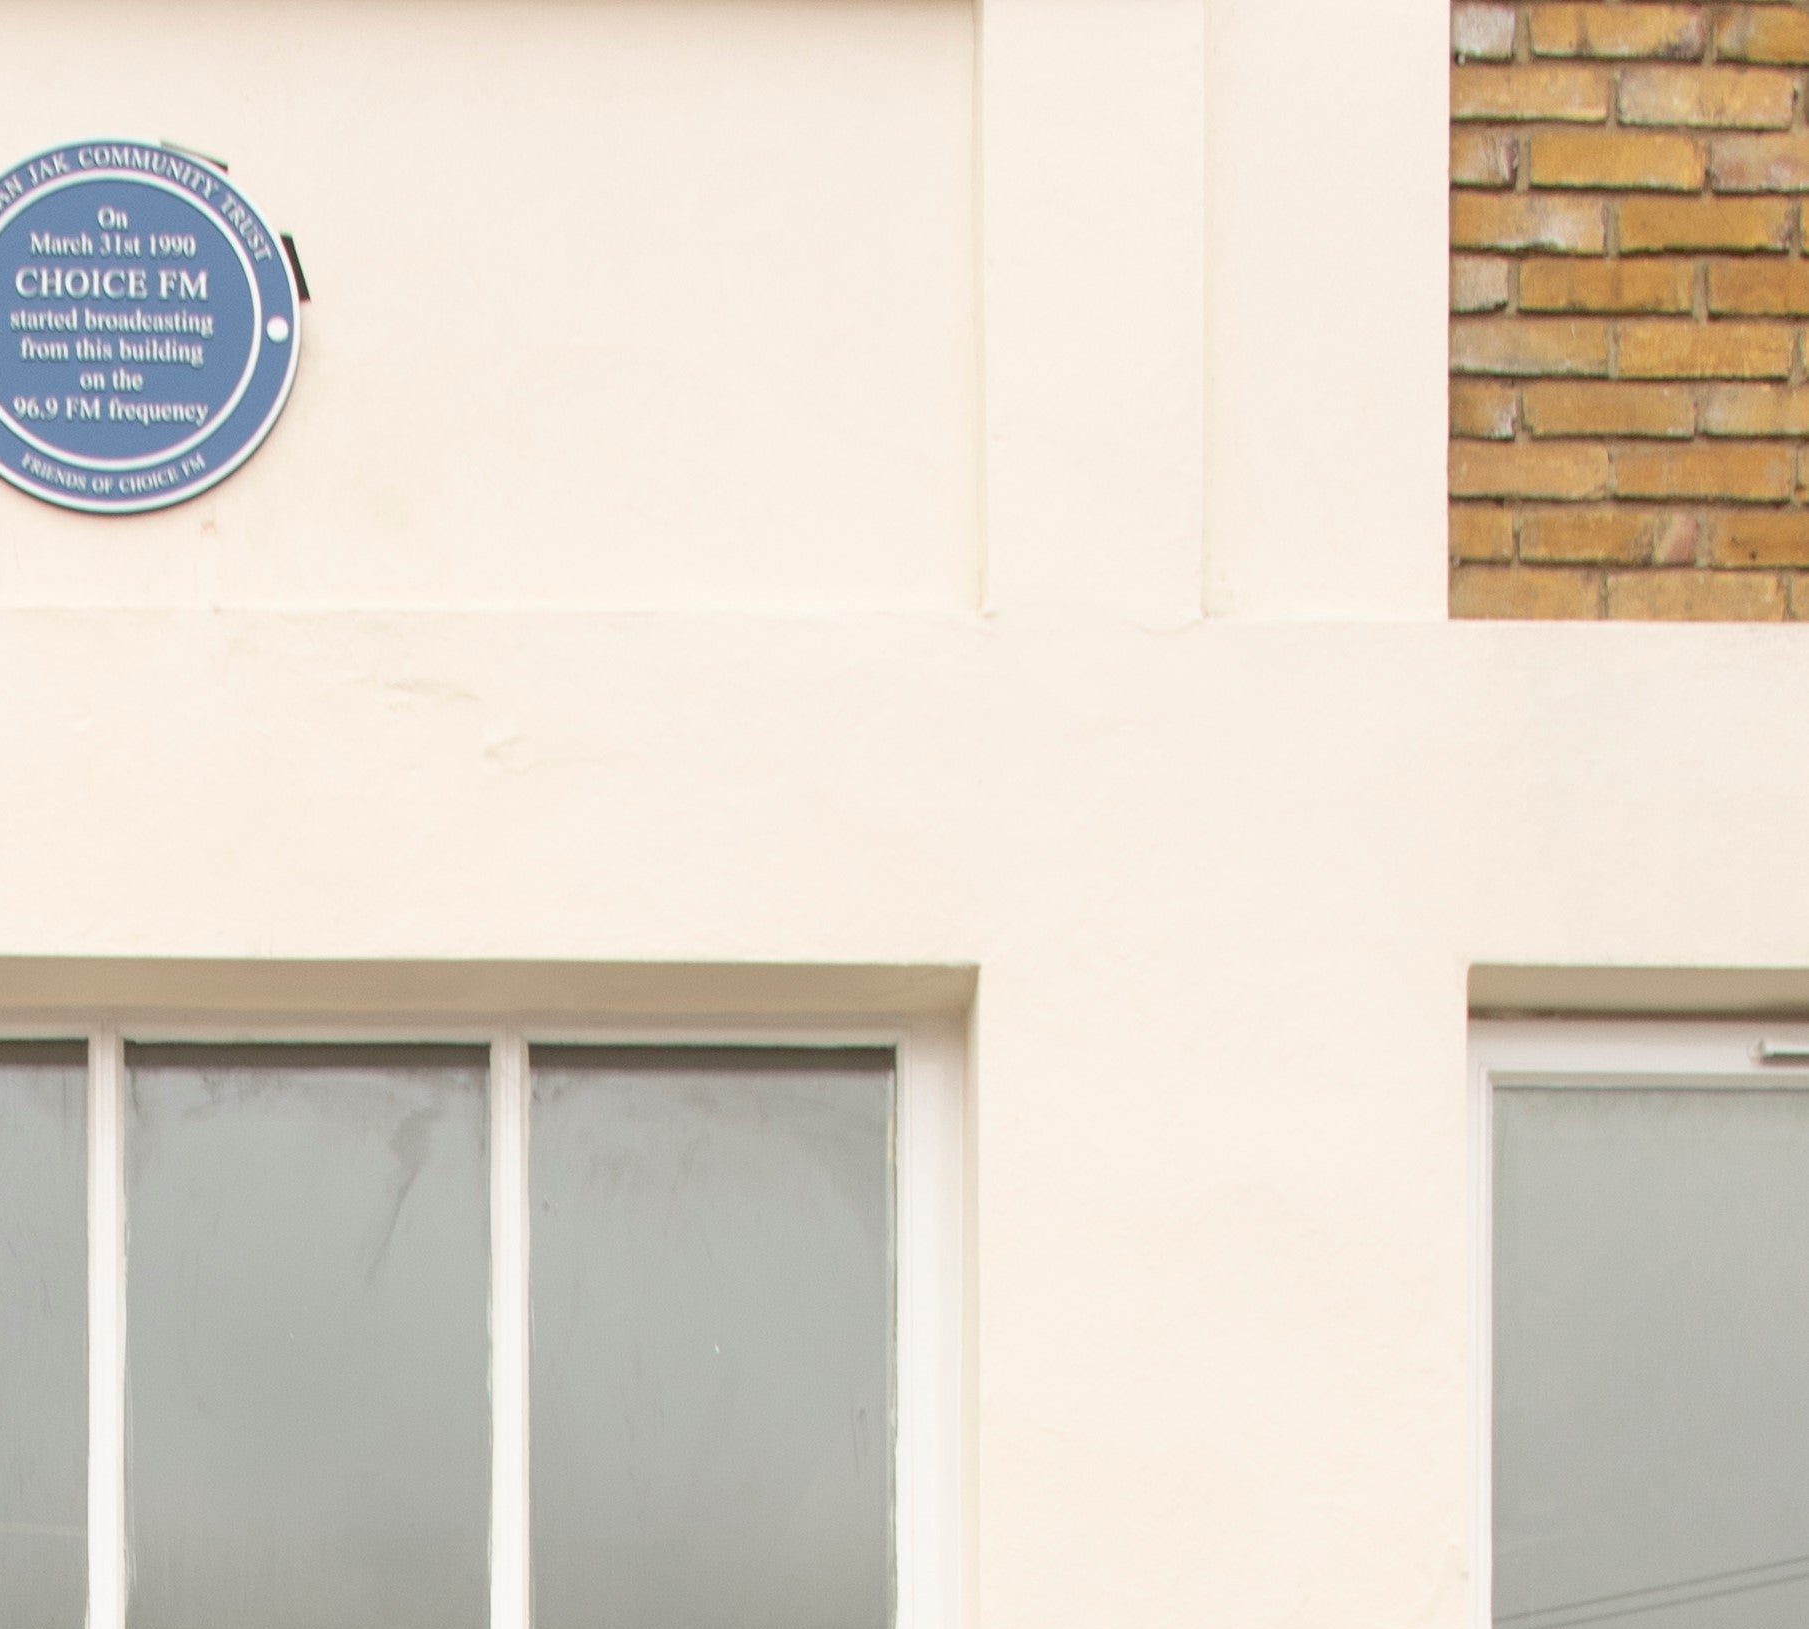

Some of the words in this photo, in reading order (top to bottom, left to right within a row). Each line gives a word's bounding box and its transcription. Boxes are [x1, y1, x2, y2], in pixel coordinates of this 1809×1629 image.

[28, 152, 70, 187] JAK
[78, 146, 219, 199] COMMUNITY
[221, 194, 272, 262] TRUST
[98, 206, 128, 230] On
[30, 231, 93, 256] March
[100, 232, 141, 257] 31st
[149, 232, 196, 258] 1990
[15, 267, 148, 299] CHOICE
[159, 268, 207, 300] FM
[10, 307, 77, 331] started
[84, 308, 214, 338] broadcasting
[21, 336, 69, 360] from
[76, 337, 112, 361] this
[119, 338, 204, 368] building
[80, 372, 105, 391] on
[112, 368, 143, 391] the
[14, 396, 58, 420] 96.9
[66, 397, 101, 420] FM
[109, 397, 208, 426] frequency
[21, 453, 87, 490] FRIENDS
[92, 474, 113, 494] OF
[119, 466, 179, 494] CHOICE
[182, 452, 206, 478] FM
